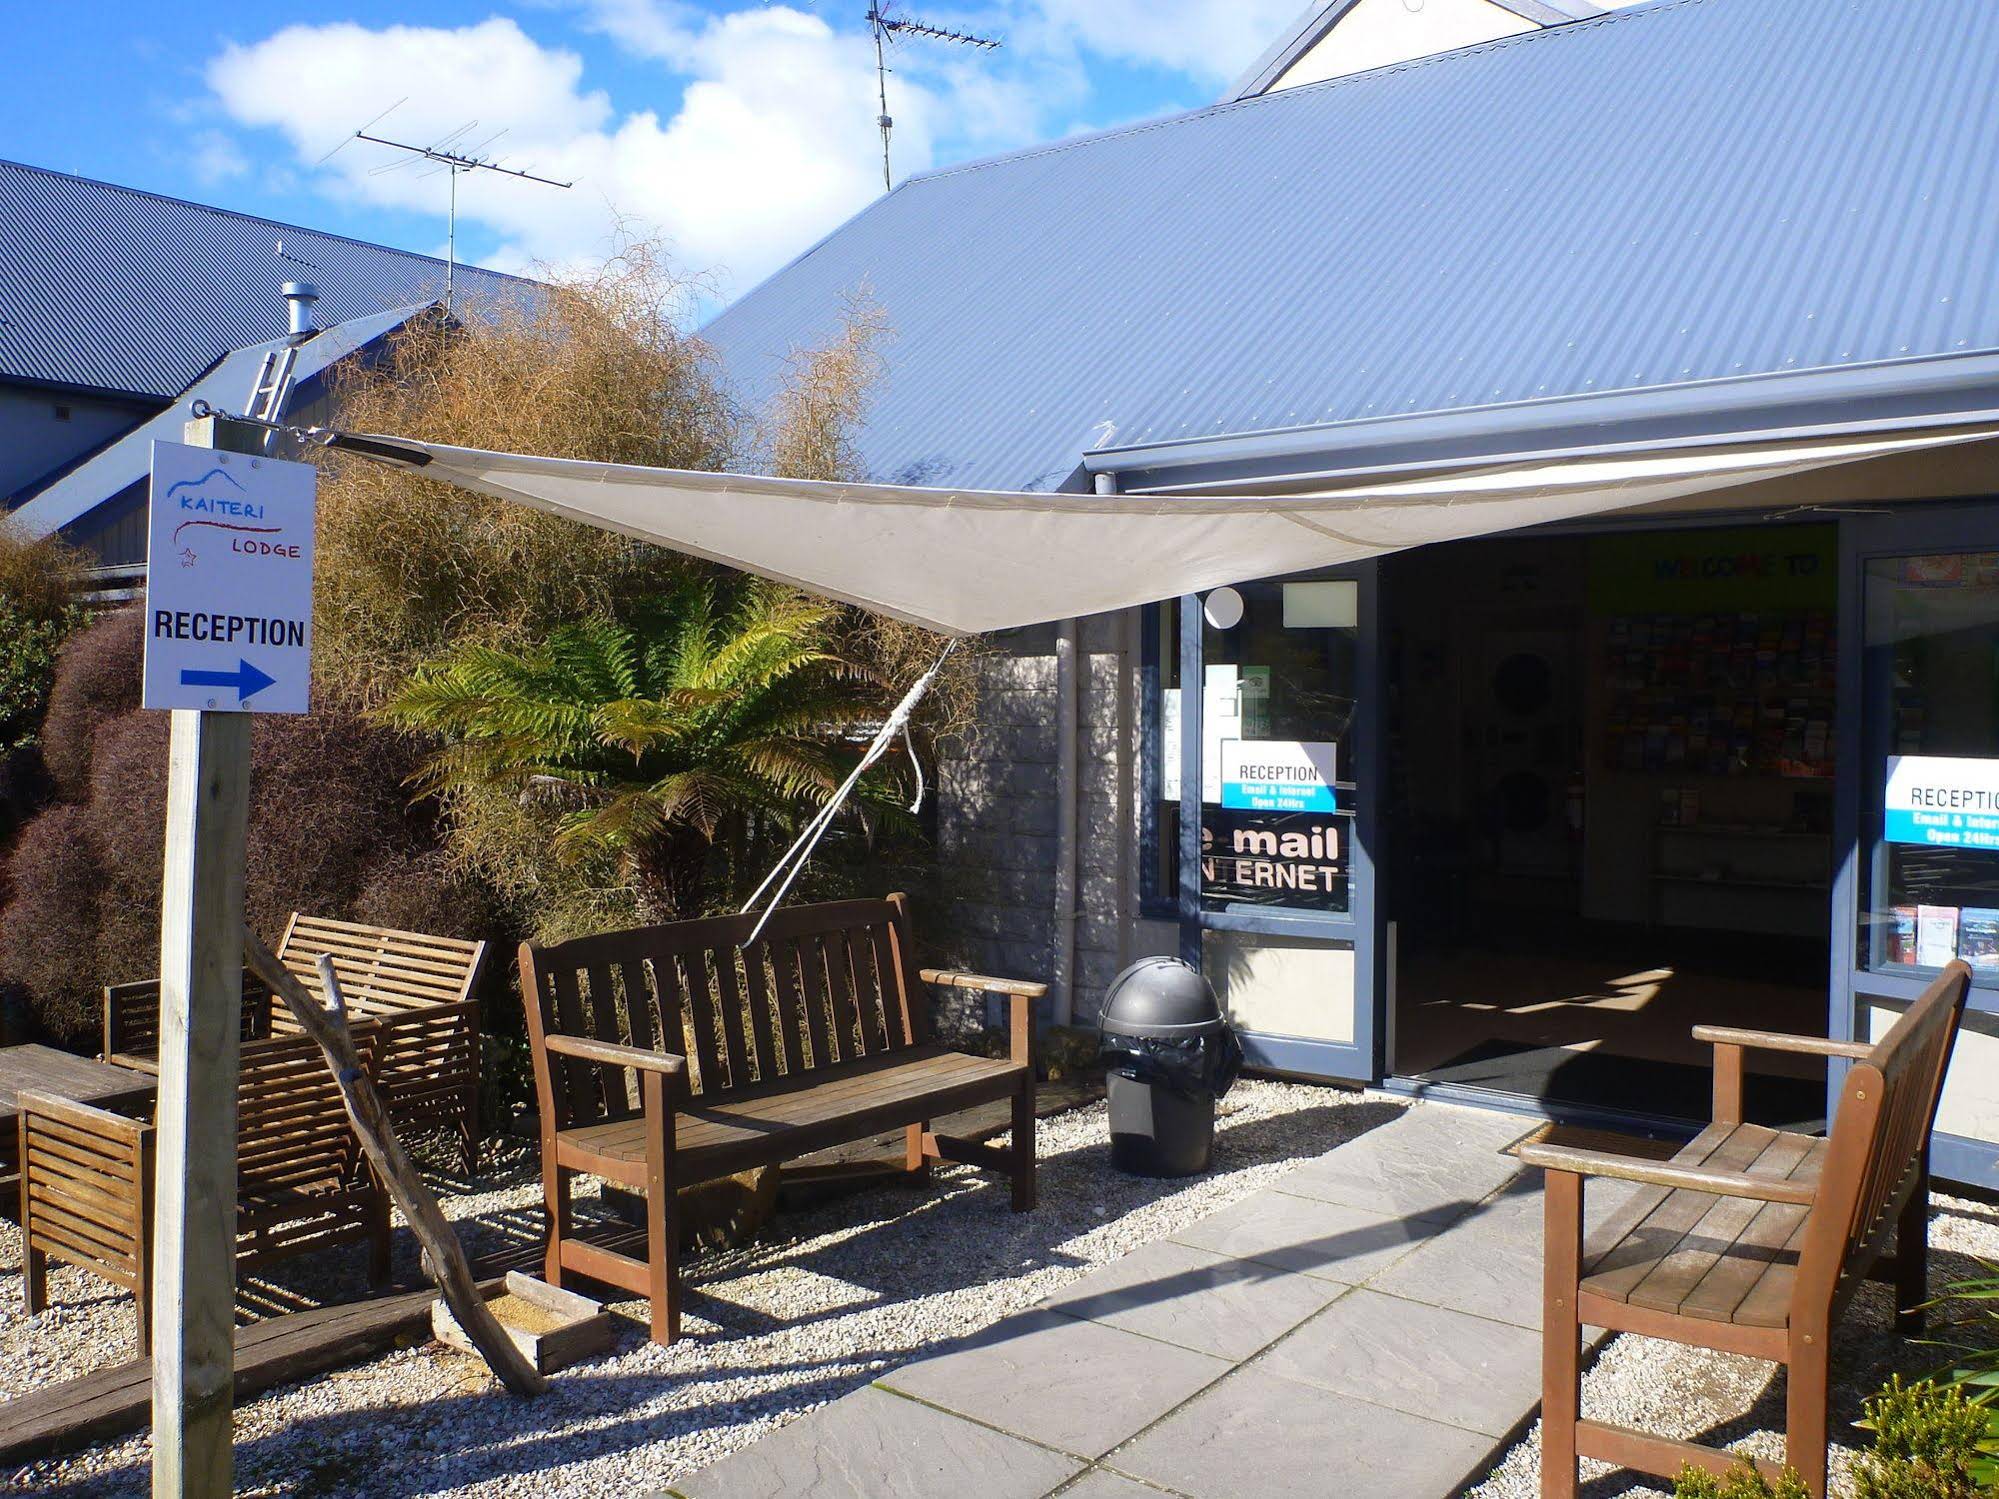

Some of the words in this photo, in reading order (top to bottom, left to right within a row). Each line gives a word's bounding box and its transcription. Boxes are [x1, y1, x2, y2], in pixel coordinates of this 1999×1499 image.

[181, 495, 264, 519] KAITERI
[232, 538, 301, 558] LODGE
[1784, 554, 1819, 577] TO
[155, 610, 305, 647] RECEPTION
[1239, 764, 1318, 781] RECEPTION
[1242, 784, 1267, 795] Email
[1279, 784, 1316, 797] Internet
[1252, 797, 1275, 809] Open
[1912, 812, 1949, 826] Email
[1952, 815, 1963, 828] &
[1967, 814, 1999, 830] Inter
[1927, 828, 1960, 845] Open
